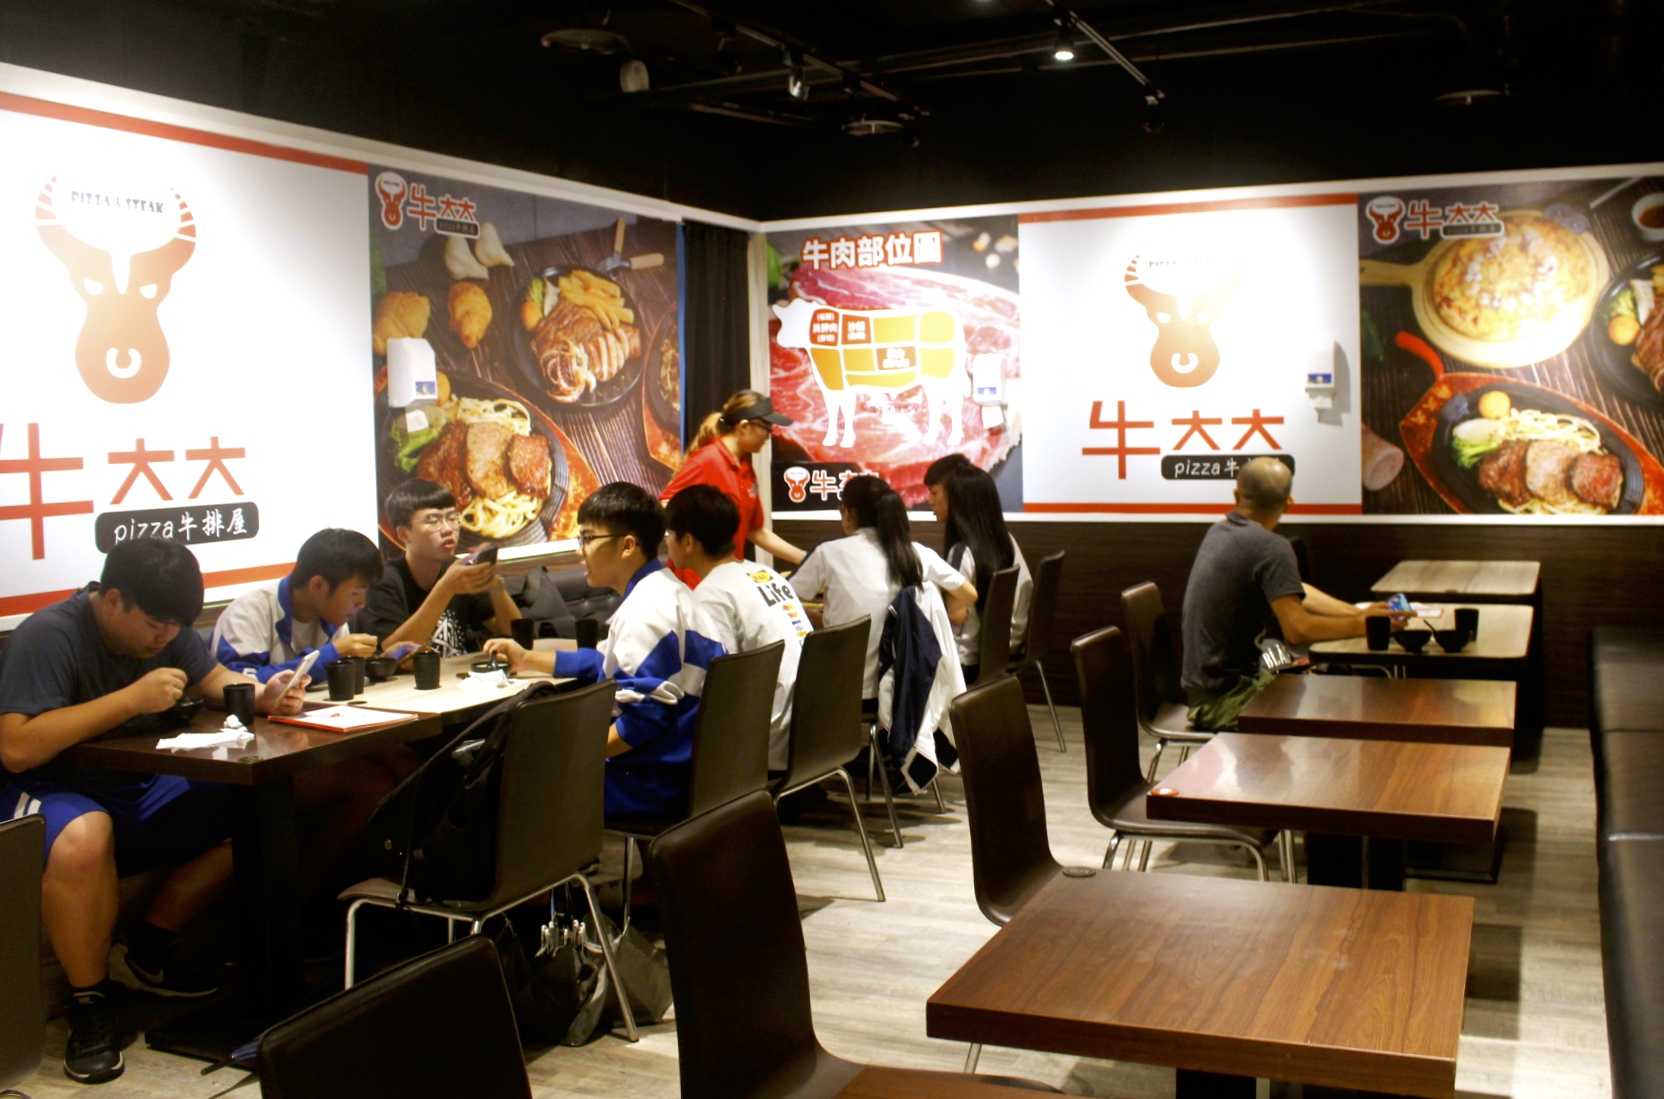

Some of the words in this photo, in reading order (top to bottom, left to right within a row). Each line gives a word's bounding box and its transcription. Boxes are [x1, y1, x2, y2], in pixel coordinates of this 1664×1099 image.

[407, 183, 476, 230] 牛大大
[1405, 200, 1498, 239] 牛大大
[1082, 400, 1284, 479] 牛大大
[1174, 457, 1279, 478] pizza牛
[757, 582, 794, 607] Life
